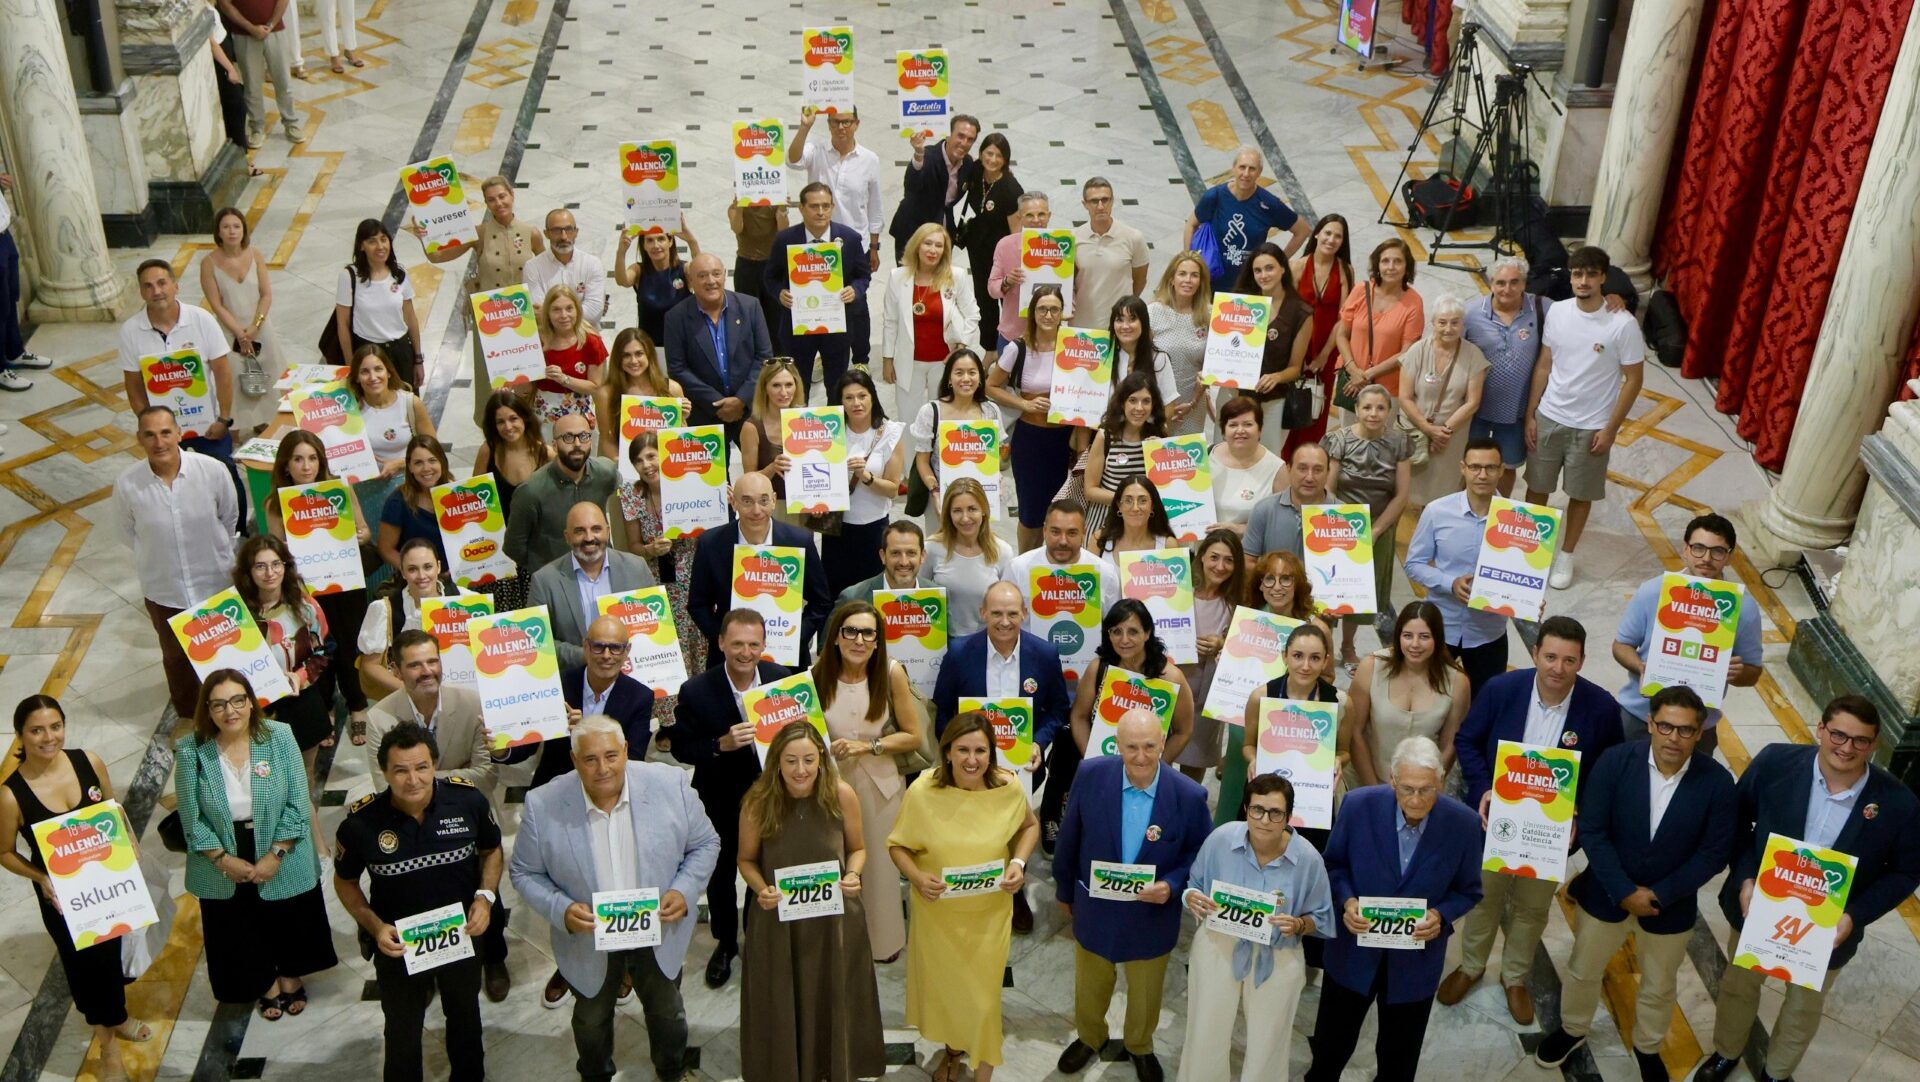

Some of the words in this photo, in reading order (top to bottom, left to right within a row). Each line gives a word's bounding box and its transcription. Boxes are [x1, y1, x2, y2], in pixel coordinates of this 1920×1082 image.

[811, 46, 843, 55] VALENCIA
[905, 69, 938, 78] VALENCIA
[741, 139, 774, 147] VALENCIA
[629, 161, 665, 171] VALENCIA
[413, 177, 448, 192] VALENCIA
[431, 208, 467, 225] vareser
[1029, 248, 1064, 257] VALENCIA
[797, 263, 831, 273] VALENCIA
[483, 306, 521, 321] VALENCIA
[1220, 313, 1256, 325] VALENCIA
[501, 342, 539, 356] mapfre
[1063, 348, 1101, 360] VALENCIA
[1207, 347, 1260, 360] CALDERONA
[153, 371, 192, 383] VALENCIA
[304, 404, 345, 421] VALENCIA
[630, 418, 669, 429] VALENCIA
[792, 430, 832, 441] VALENCIA
[948, 442, 987, 452] VALENCIA
[670, 451, 712, 463] VALENCIA
[1155, 458, 1196, 472] VALENCIA
[445, 499, 486, 517] VALENCIA
[665, 499, 712, 514] grupotec
[294, 506, 338, 521] VALENCIA
[1313, 528, 1357, 538] VALENCIA
[1497, 522, 1541, 541] VALENCIA
[295, 547, 357, 566] cecotec
[463, 543, 496, 558] Dacsa
[759, 556, 768, 567] 18
[744, 571, 788, 583] VALENCIA
[1055, 575, 1063, 586] 18
[1131, 574, 1178, 586] VALENCIA
[1479, 568, 1541, 589] FERMAX
[1040, 590, 1086, 601] VALENCIA
[1690, 587, 1700, 600] 18
[624, 600, 633, 611] 18
[899, 599, 908, 611] 18
[1670, 601, 1721, 621] VALENCIA
[199, 613, 209, 626] 18
[620, 611, 658, 625] ALENCIA
[885, 614, 931, 626] VALENCIA
[191, 619, 240, 647] VALENCIA
[434, 622, 468, 634] VALEN
[498, 624, 508, 637] 18
[1053, 634, 1078, 643] REX
[1240, 632, 1281, 652] VALENCIA
[484, 637, 537, 657] VALENCIA
[1665, 640, 1715, 659] BdB
[634, 651, 678, 664] Levantina
[1129, 682, 1138, 695] 18
[485, 686, 560, 711] aquaservice
[771, 693, 780, 707] 18
[1111, 695, 1156, 711] VALENCIA
[760, 703, 807, 726] VALENCIA
[992, 724, 1018, 735] NCIA
[1270, 725, 1321, 740] VALENCIA
[1526, 756, 1535, 769] 18
[1507, 771, 1559, 789] VALENCIA
[439, 817, 464, 825] POLICIA
[1523, 821, 1565, 833] Universidad
[67, 823, 78, 837] 18
[436, 826, 469, 836] VALENCIA
[1522, 828, 1550, 838] Católica
[55, 834, 111, 858] VALENCIA
[1521, 834, 1552, 845] Valencia
[1797, 854, 1807, 867] 18
[950, 878, 995, 891] 2026
[1774, 866, 1831, 891] VALENCIA
[1100, 877, 1145, 894] 2026
[70, 879, 137, 912] sklum
[788, 883, 833, 905] 2026
[605, 911, 651, 933] 2026
[1218, 903, 1265, 928] 2026
[1368, 917, 1416, 935] 2026
[414, 927, 460, 957] 2026
